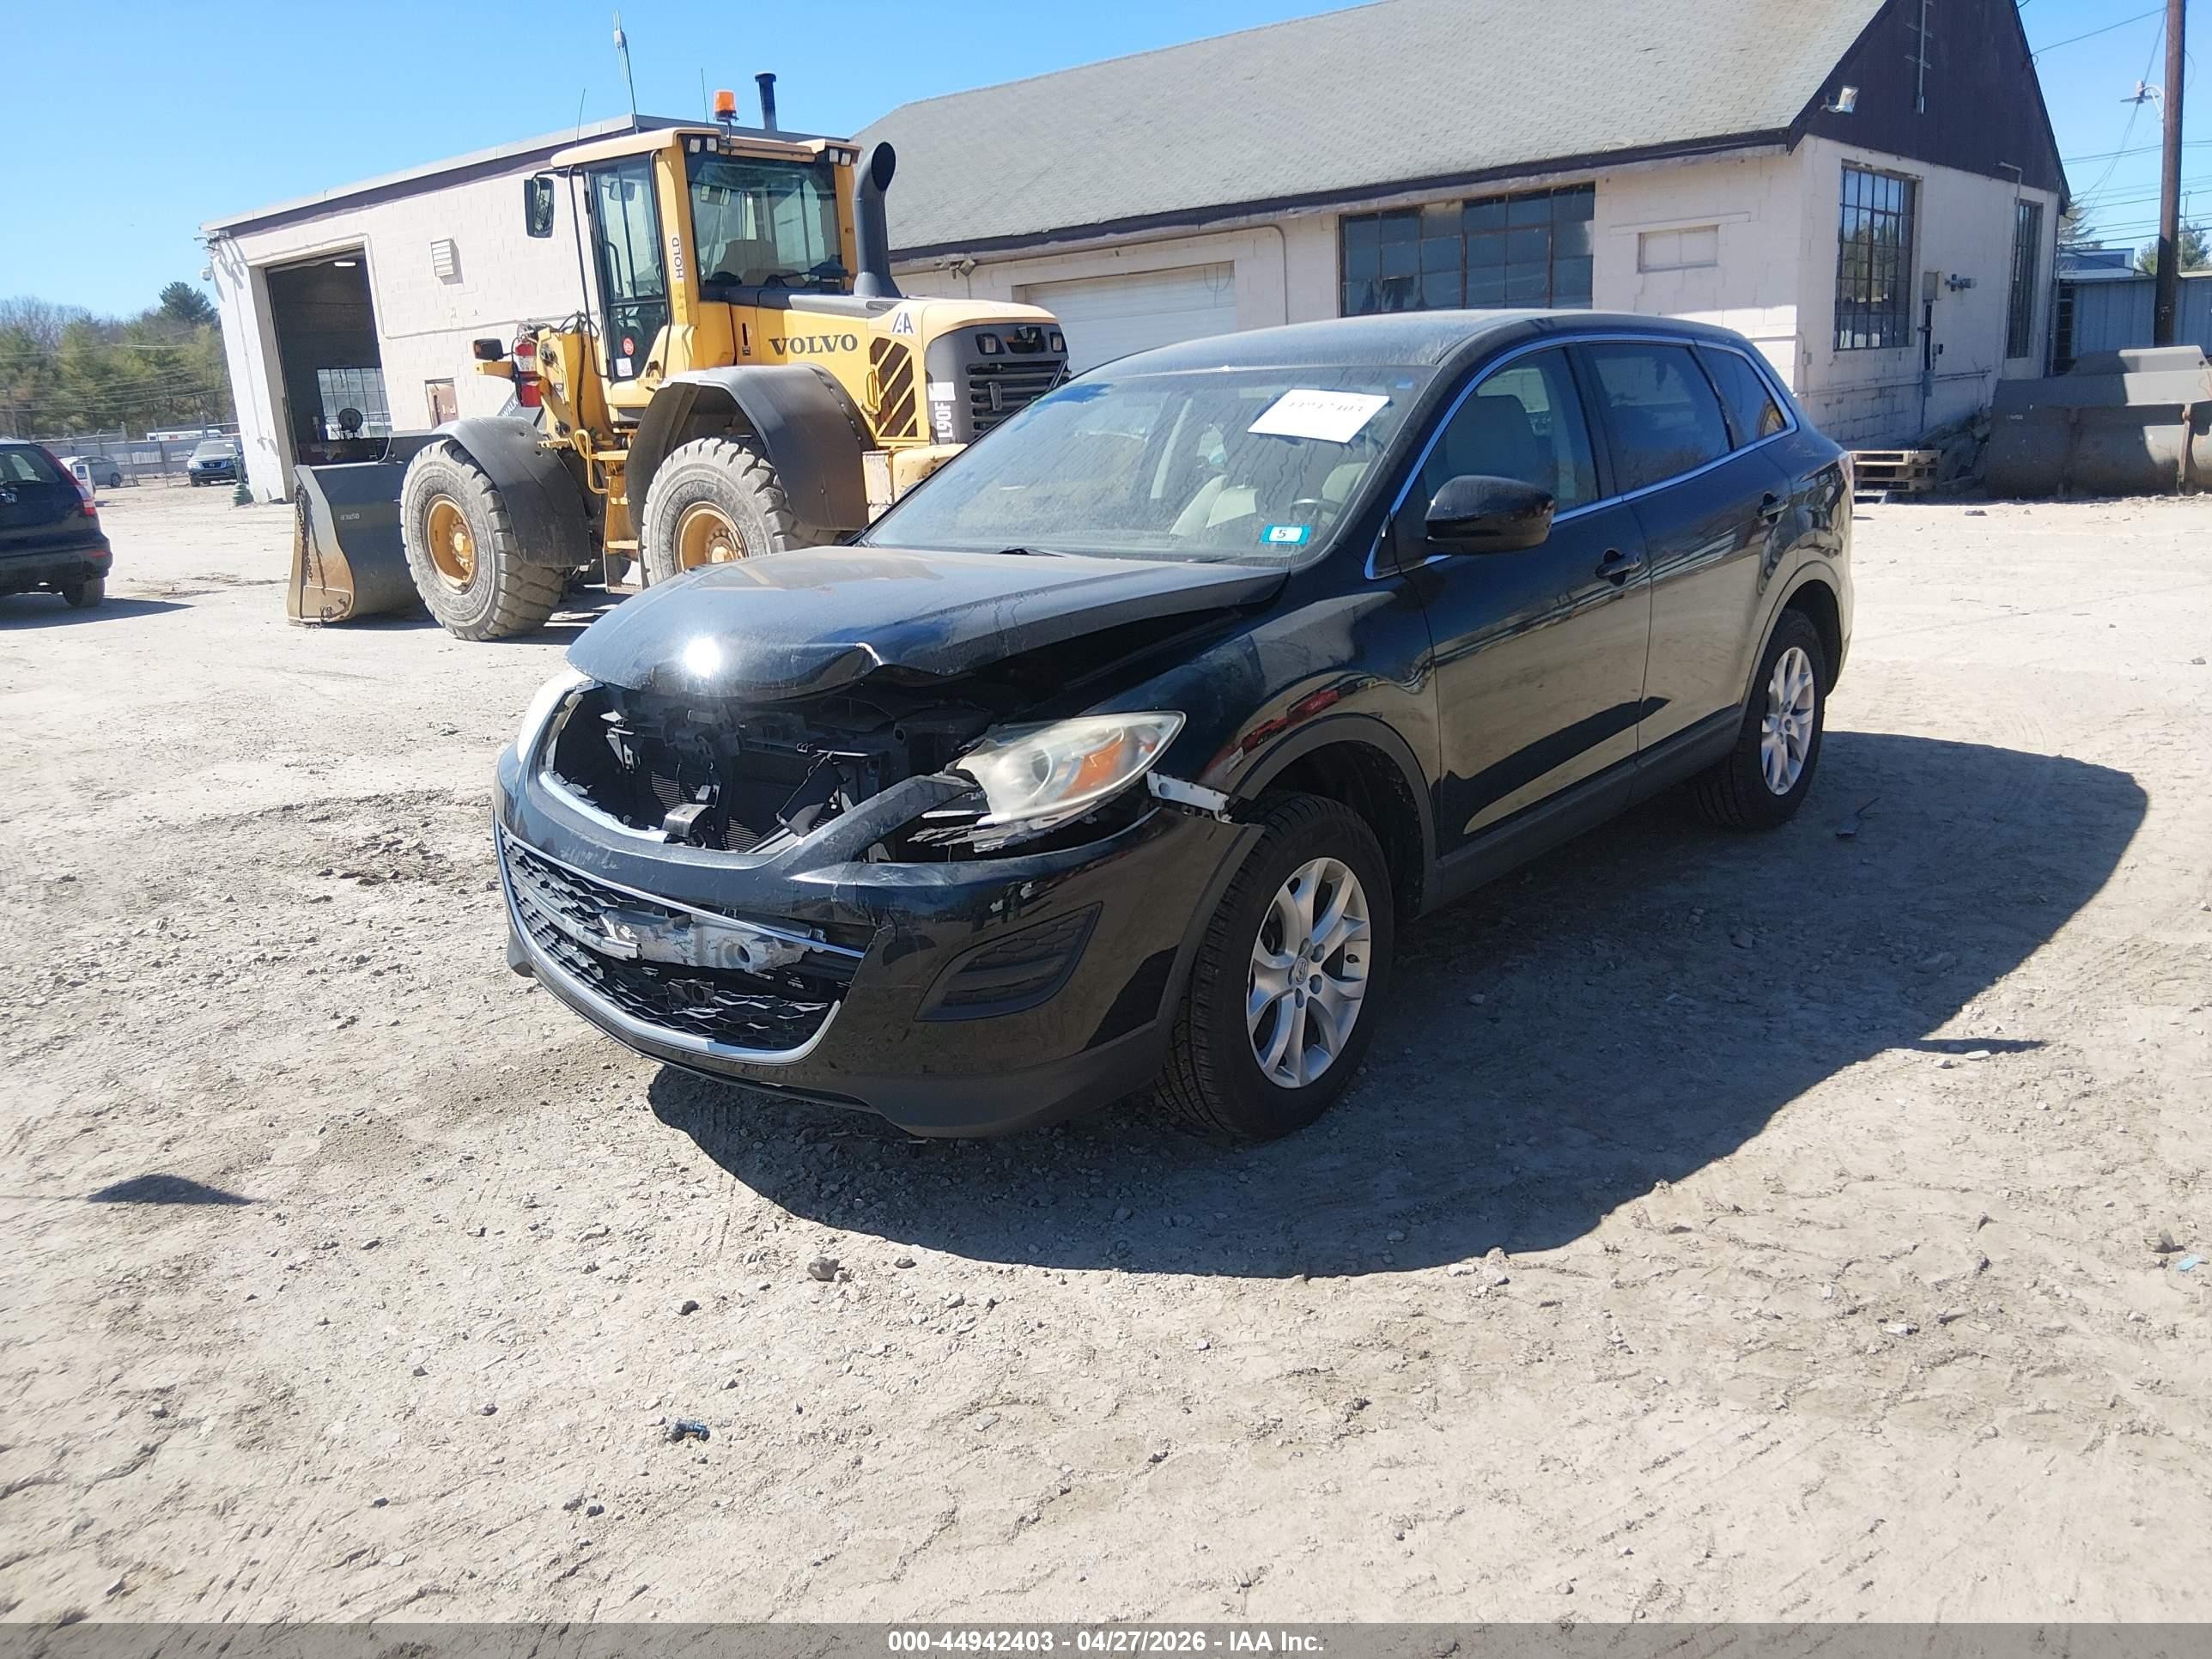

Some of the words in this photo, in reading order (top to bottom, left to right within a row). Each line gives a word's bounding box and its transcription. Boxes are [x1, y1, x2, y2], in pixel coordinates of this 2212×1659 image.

[672, 237, 684, 279] HOLD
[769, 334, 859, 356] VOLVO
[934, 402, 953, 438] L90F
[1276, 529, 1287, 538] 5
